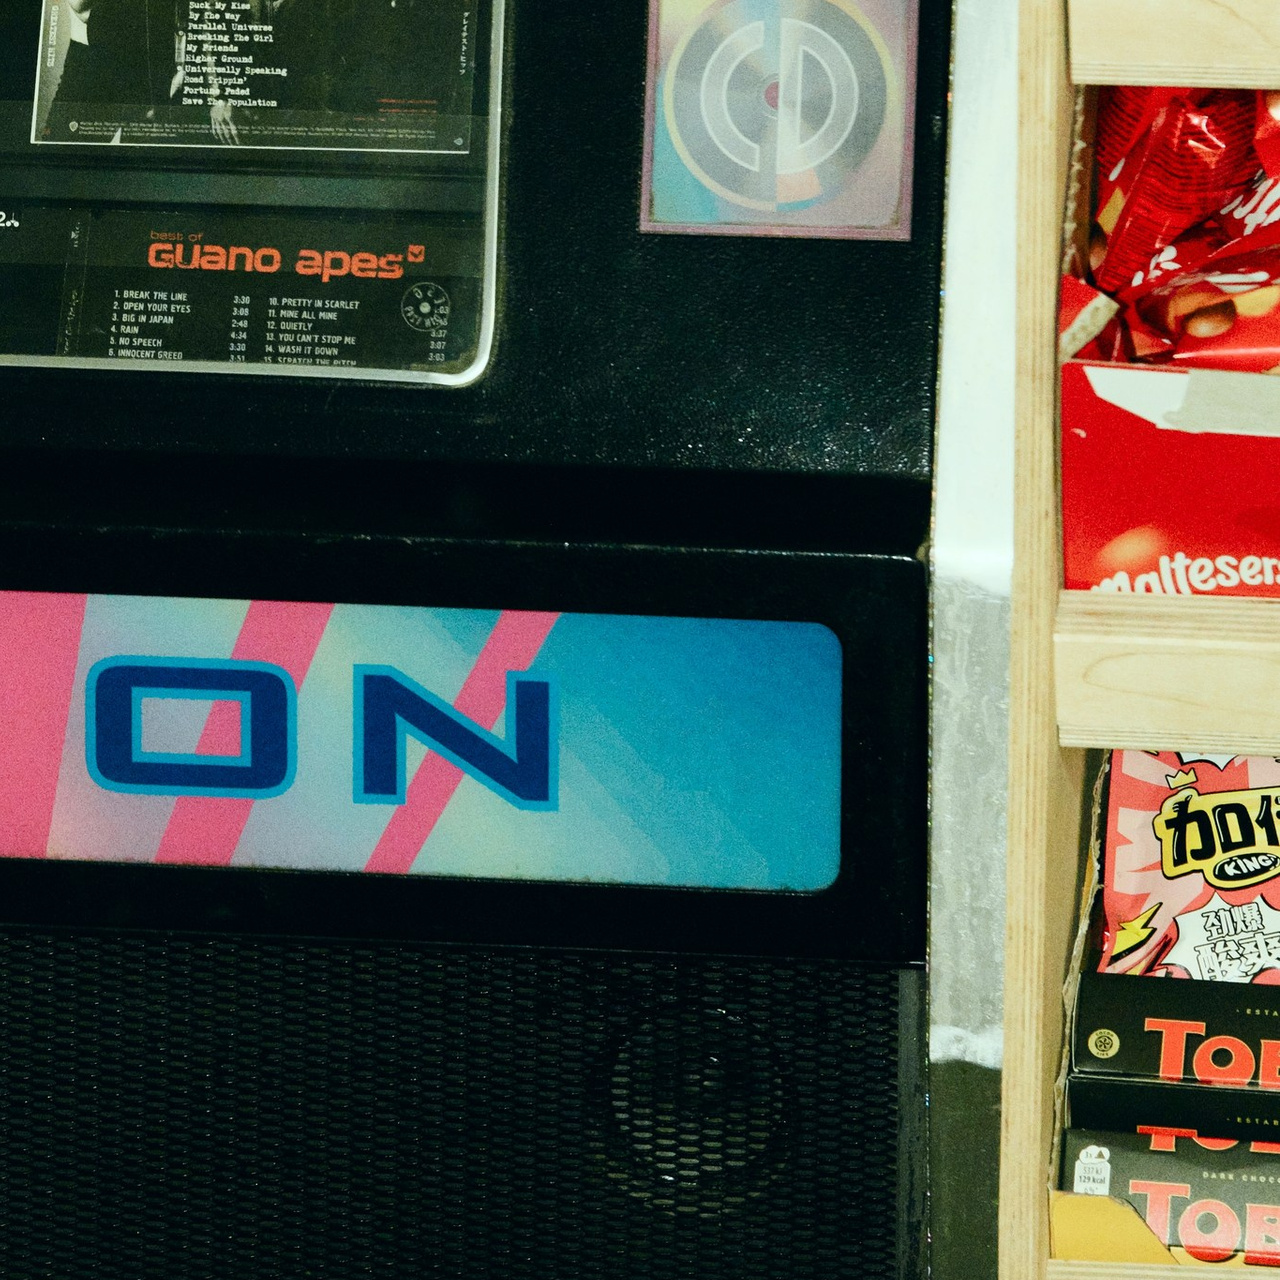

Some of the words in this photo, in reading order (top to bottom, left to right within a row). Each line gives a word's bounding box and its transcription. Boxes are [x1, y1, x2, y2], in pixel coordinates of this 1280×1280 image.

[295, 249, 405, 283] apes
[84, 654, 560, 812] ON
[1201, 902, 1265, 942] 劲爆
